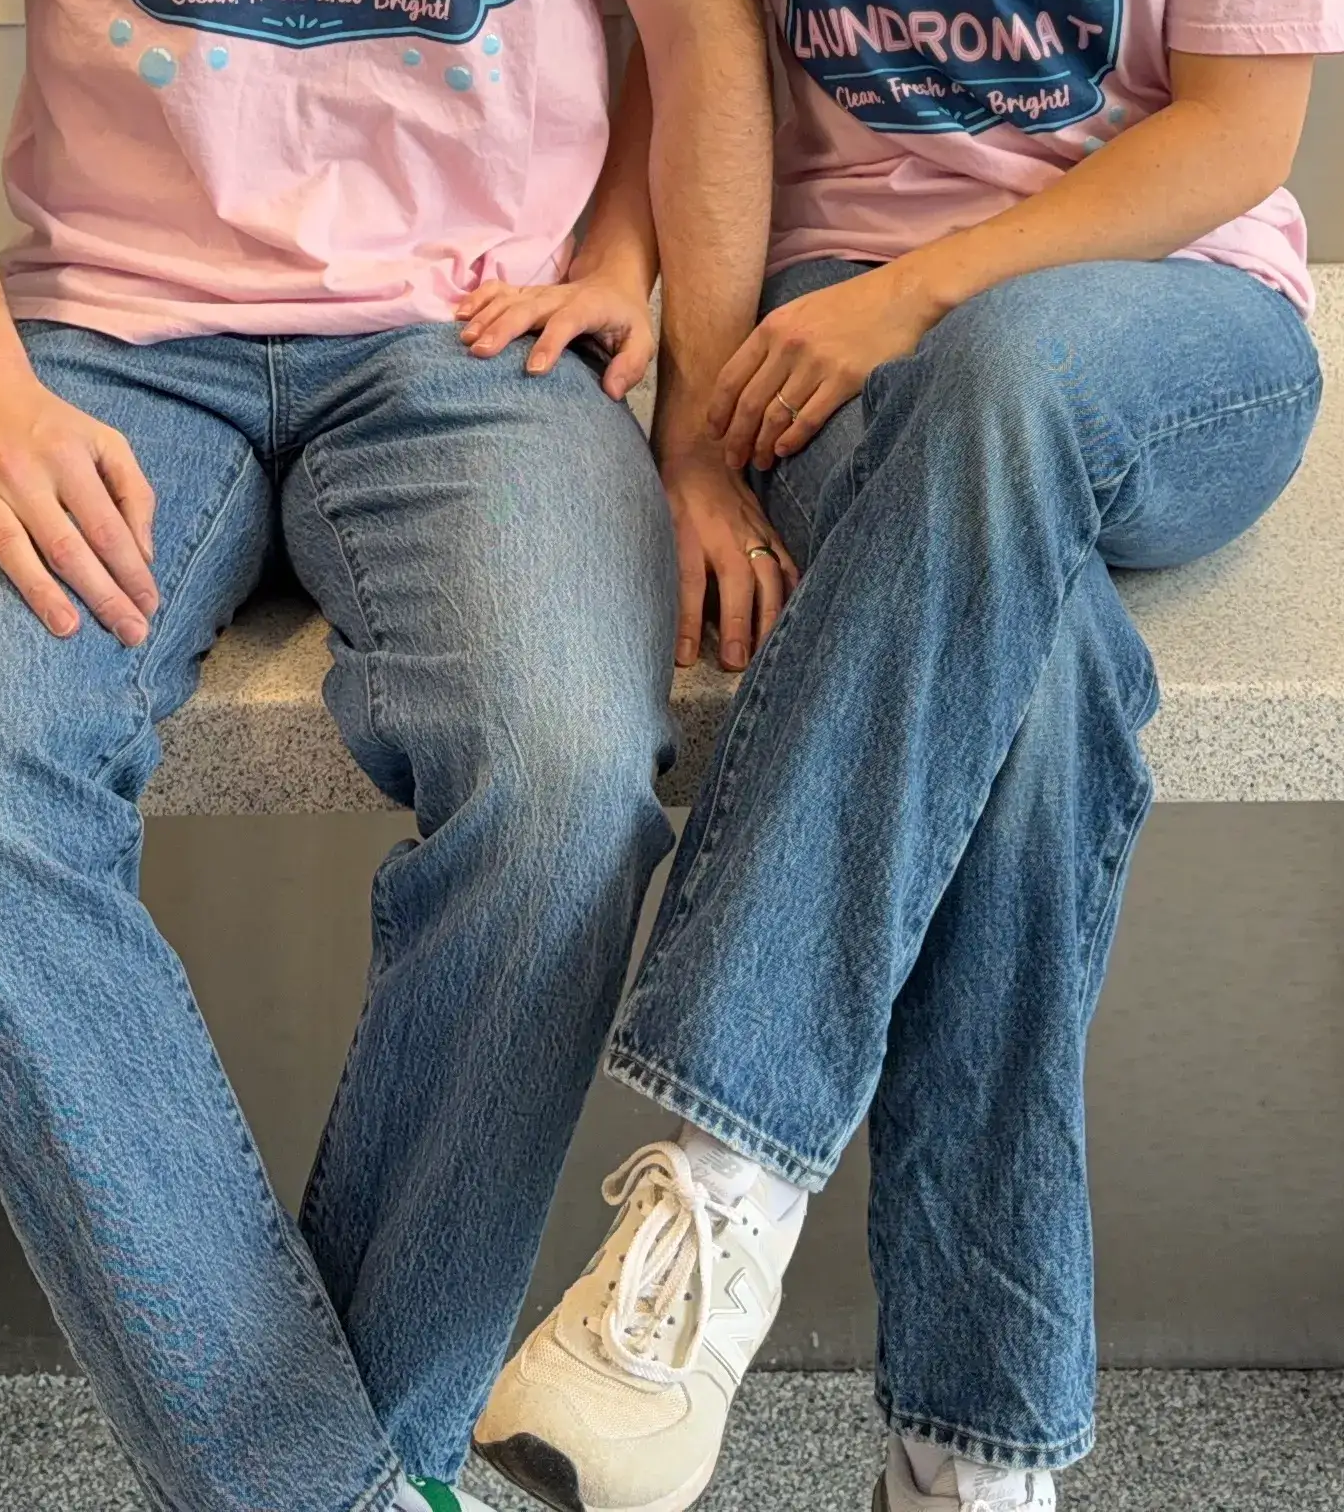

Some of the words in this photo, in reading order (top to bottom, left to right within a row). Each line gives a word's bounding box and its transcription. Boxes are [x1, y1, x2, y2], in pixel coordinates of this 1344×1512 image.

[794, 4, 1102, 63] LAUNDROMAT
[887, 77, 945, 102] Fresh
[988, 84, 1070, 119] Bright!
